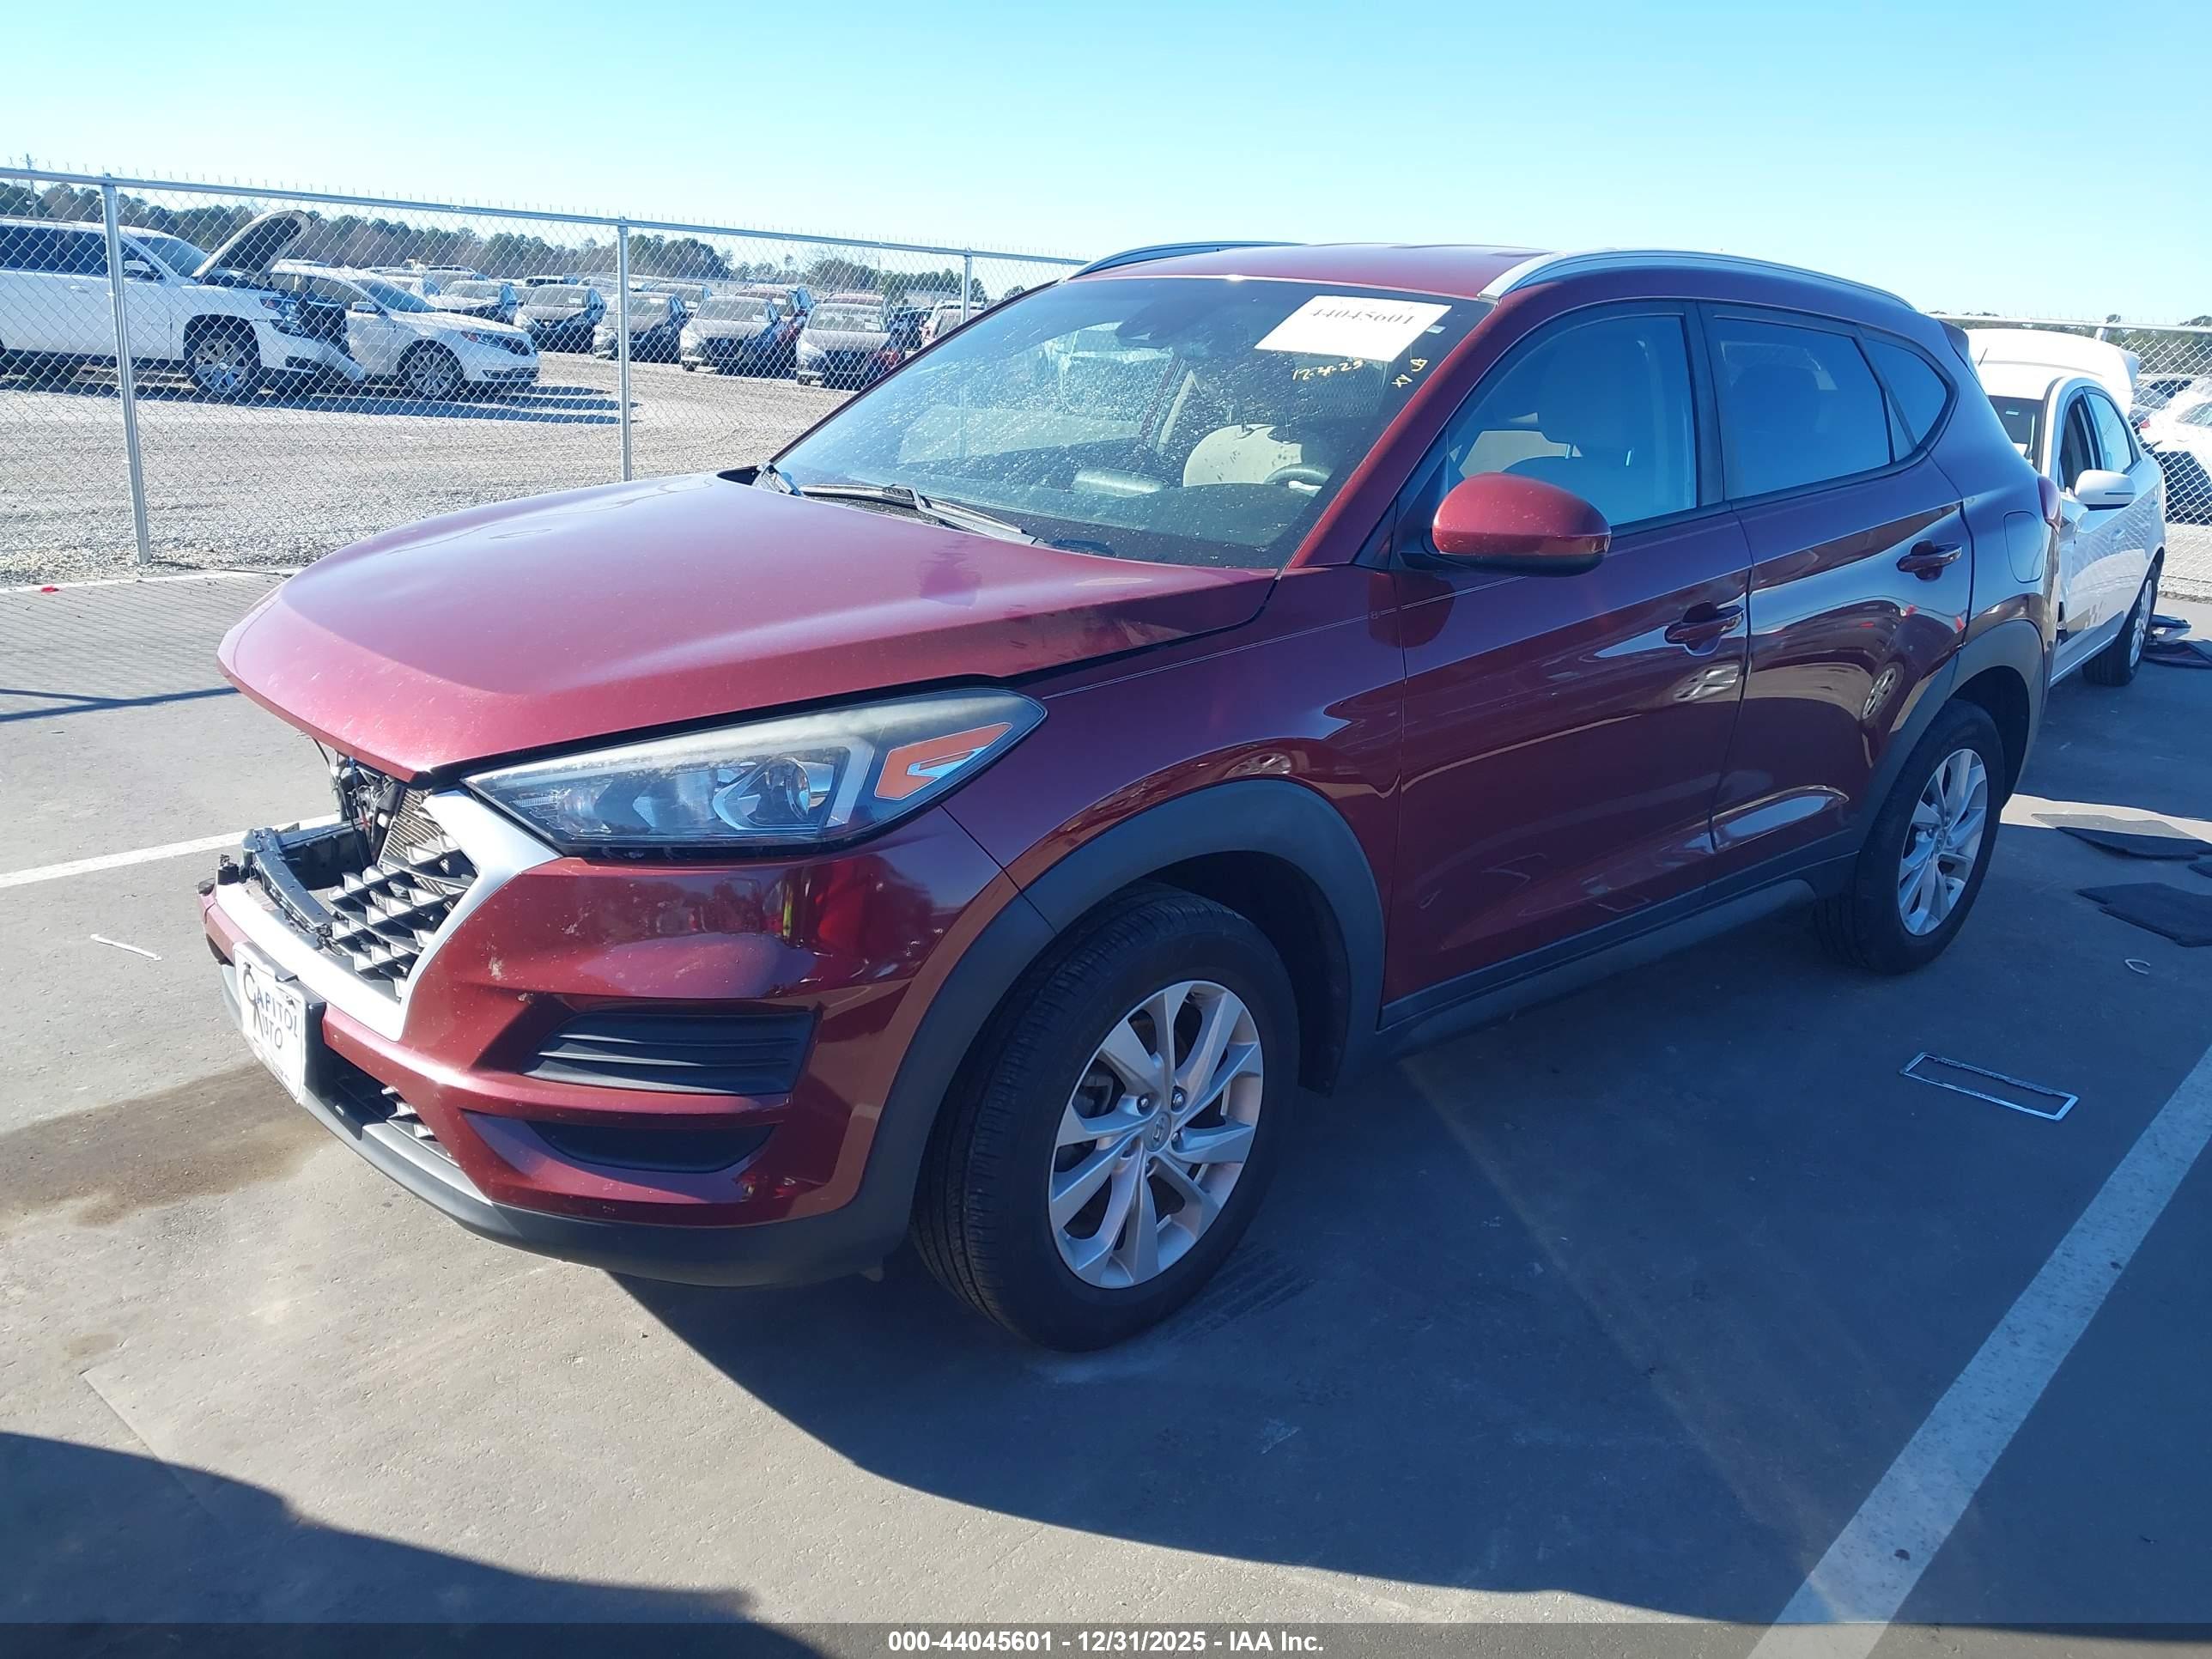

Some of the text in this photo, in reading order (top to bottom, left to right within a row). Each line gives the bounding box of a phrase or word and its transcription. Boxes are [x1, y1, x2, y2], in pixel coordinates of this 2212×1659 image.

[1310, 308, 1415, 325] 44045601
[243, 968, 298, 1038] CAPITOL
[253, 992, 283, 1049] AUTO
